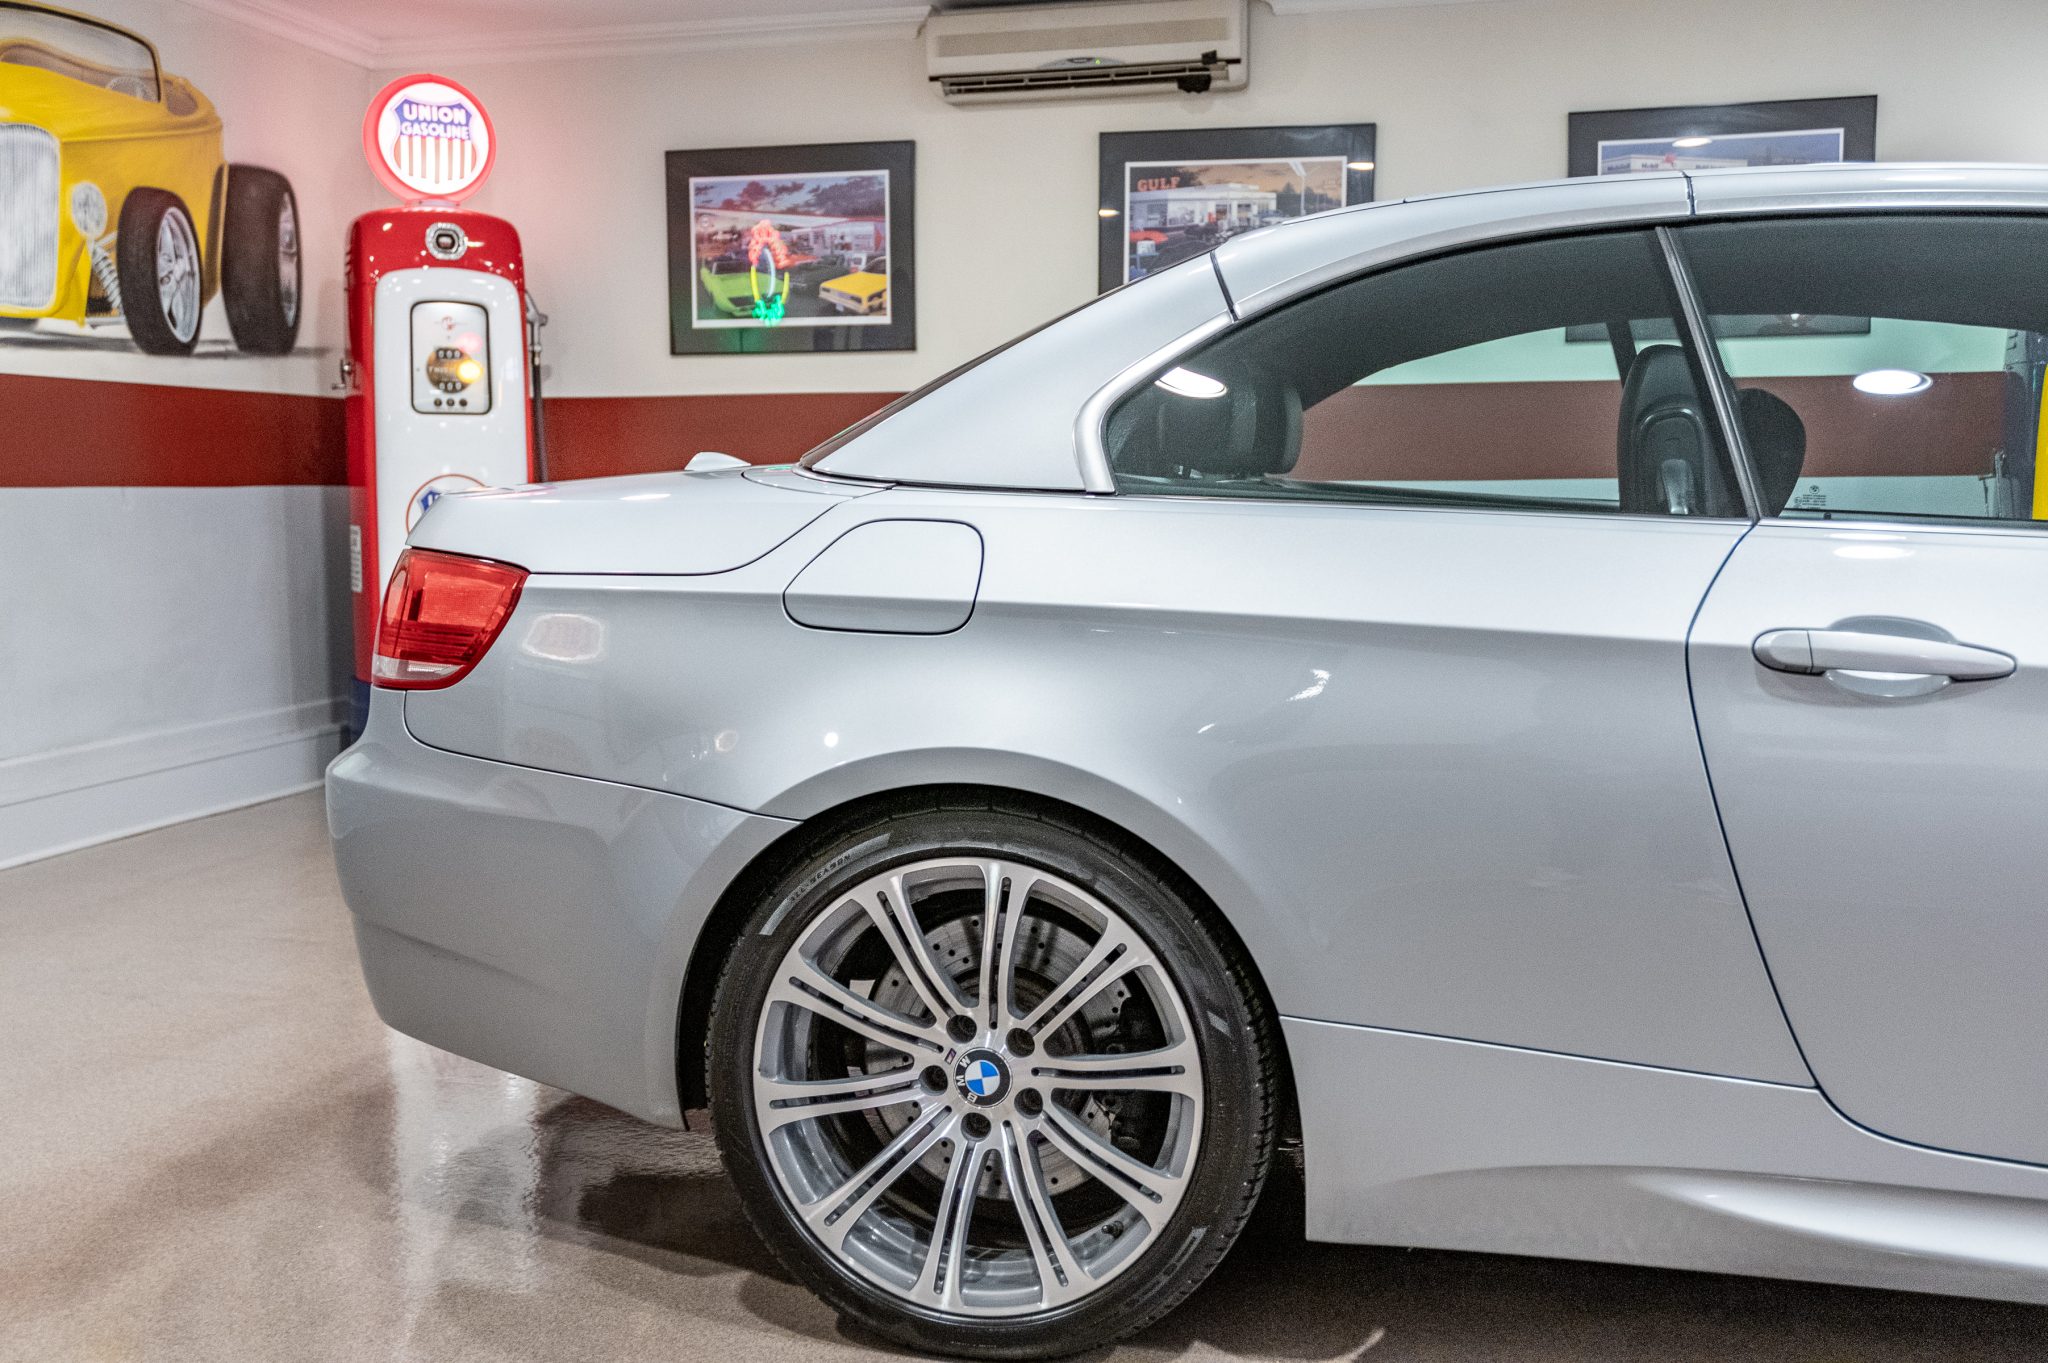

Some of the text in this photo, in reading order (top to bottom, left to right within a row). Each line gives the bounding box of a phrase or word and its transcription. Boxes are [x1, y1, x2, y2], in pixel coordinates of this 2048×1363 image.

[403, 103, 466, 124] UNION
[401, 122, 470, 140] GASOLINE
[1137, 177, 1180, 192] GULF
[956, 1056, 977, 1103] BMW
